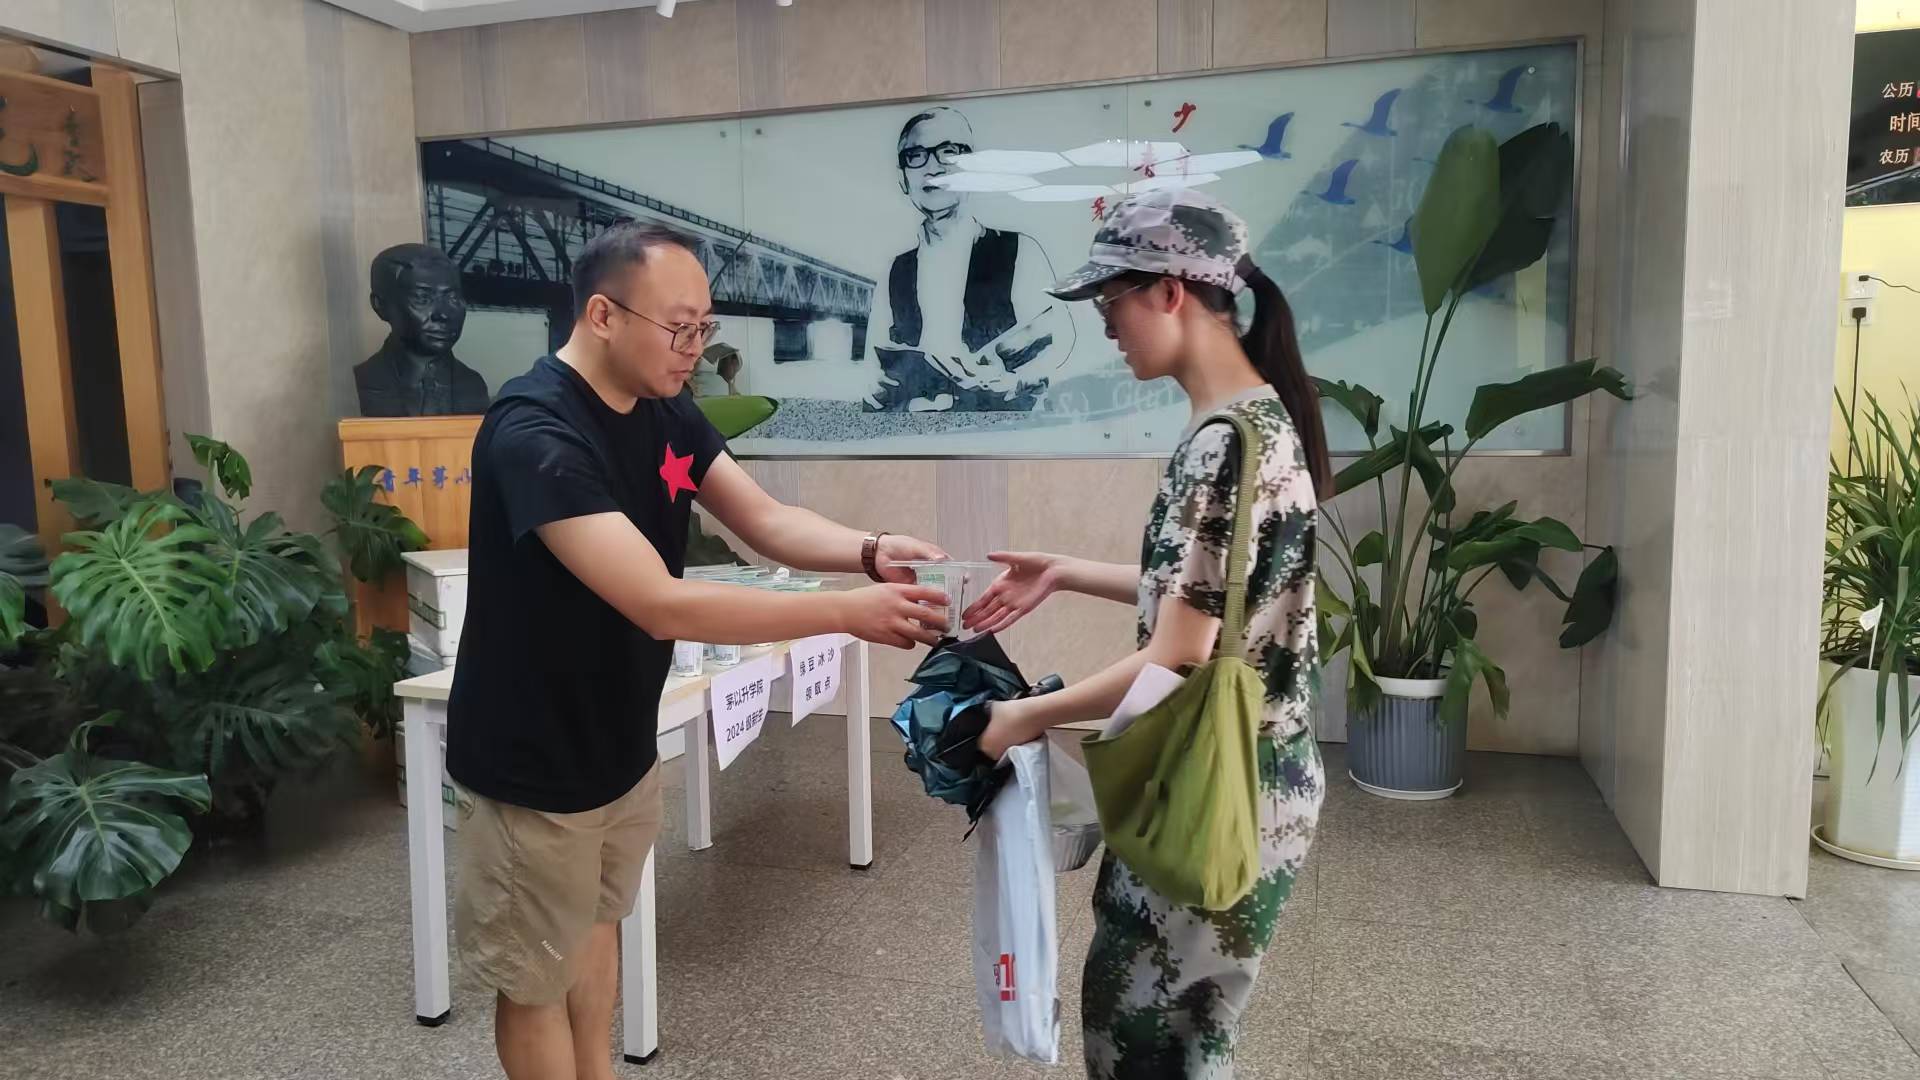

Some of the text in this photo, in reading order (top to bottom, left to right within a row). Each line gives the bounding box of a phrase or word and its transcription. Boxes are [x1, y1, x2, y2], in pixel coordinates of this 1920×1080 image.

[1882, 82, 1914, 98] 公历
[1889, 112, 1920, 132] 时间
[1879, 148, 1911, 165] 农历
[799, 647, 835, 677] 绿豆冰沙
[725, 678, 764, 711] 茅以升学院
[805, 676, 832, 701] 领取点
